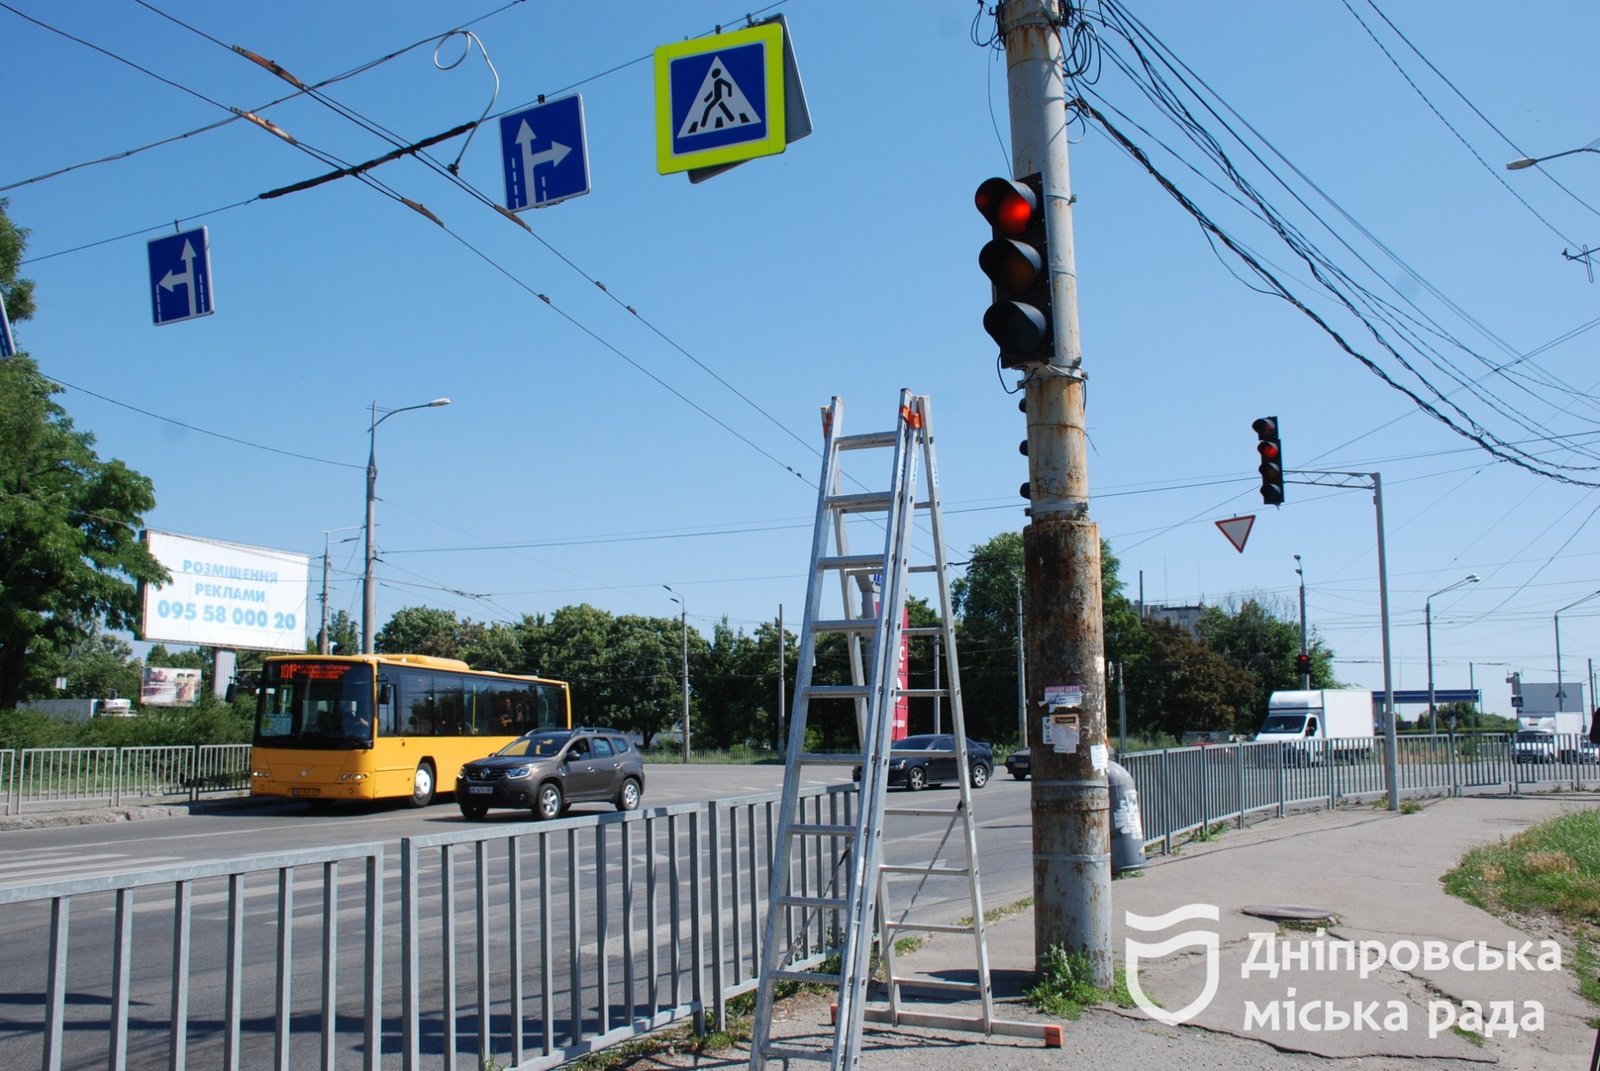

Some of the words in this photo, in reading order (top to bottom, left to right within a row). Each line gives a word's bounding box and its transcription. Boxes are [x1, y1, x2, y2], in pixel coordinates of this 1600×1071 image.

[183, 560, 278, 584] РОЗМІЩЕННЯ
[195, 583, 266, 603] РЕКЛАМИ
[157, 600, 197, 620] 095
[203, 605, 227, 623] 58
[232, 608, 268, 628] 000
[274, 612, 296, 630] 20
